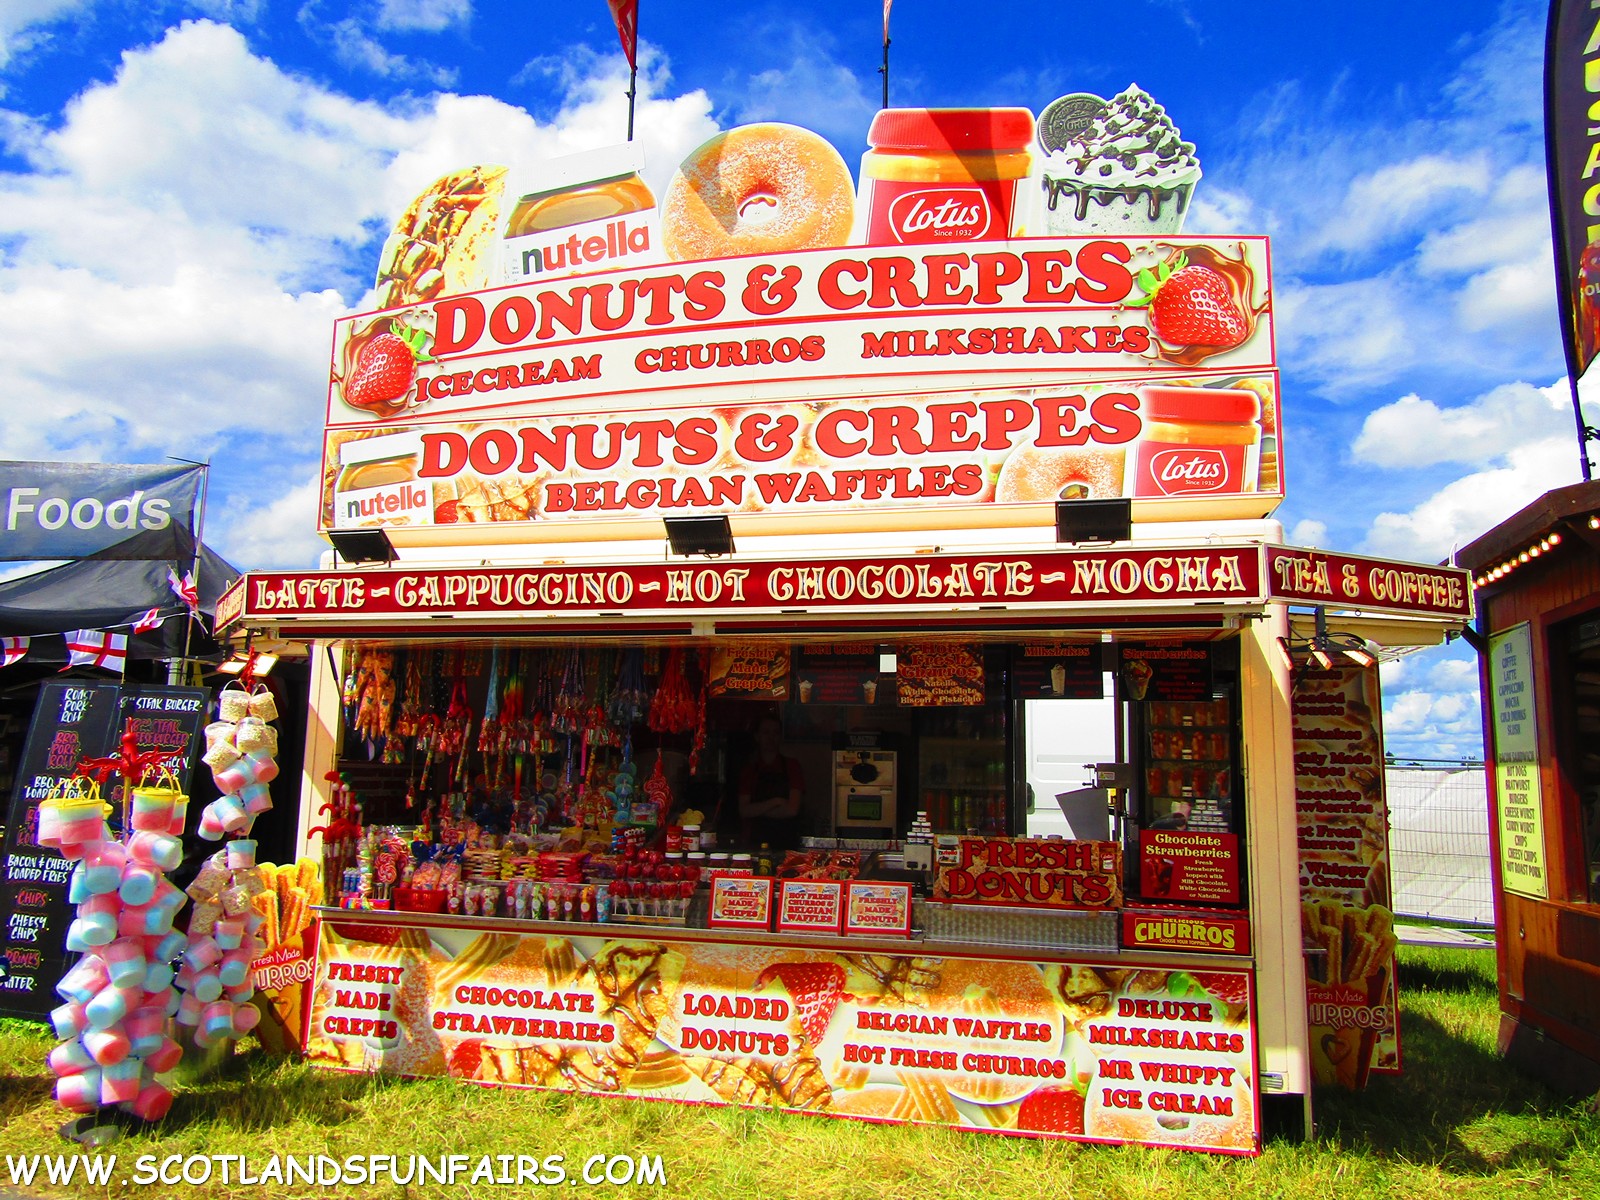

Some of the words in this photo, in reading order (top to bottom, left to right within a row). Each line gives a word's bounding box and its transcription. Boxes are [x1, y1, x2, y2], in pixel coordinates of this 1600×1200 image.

[902, 197, 980, 233] Lotus
[934, 229, 953, 237] Since
[955, 229, 972, 237] 1932
[522, 221, 650, 275] nutella
[430, 273, 725, 357] DONUTS
[742, 265, 802, 316] &
[817, 240, 1134, 309] CREPES
[415, 354, 602, 402] ICECREAM
[635, 335, 825, 374] CHURROS
[861, 326, 1151, 359] MILKSHAKES
[417, 407, 718, 478] DONUTS
[735, 413, 798, 462] &
[815, 393, 1143, 458] CREPES
[1160, 456, 1221, 481] Lotus
[544, 475, 746, 513] BELGIAN
[755, 464, 983, 506] WAFFLES
[1185, 478, 1200, 486] Since
[7, 487, 171, 530] Foods
[347, 484, 427, 518] nutella
[255, 577, 365, 609] LATTE
[395, 570, 633, 607] CAPPUCCINO
[665, 567, 750, 604] HOT
[766, 560, 1035, 602] CHOCOLATE
[1069, 555, 1246, 596] MOCHA
[1274, 555, 1333, 595] TEA
[1342, 564, 1360, 597] &
[1369, 567, 1464, 608] COFFEE
[732, 663, 768, 674] Made
[911, 654, 966, 666] Fresh
[726, 677, 772, 691] Crepes
[901, 666, 978, 679] Churros
[64, 700, 88, 711] PORK
[65, 688, 95, 700] ROAST
[136, 698, 162, 710] STEAK
[165, 699, 200, 711] BURGER
[34, 776, 54, 787] BBQ
[1155, 833, 1221, 846] Chocolate
[8, 854, 36, 867] BACON
[46, 857, 74, 870] CHEESE
[961, 840, 1093, 871] FRESH
[1146, 845, 1231, 858] Strawberries
[8, 867, 40, 880] LOADED
[945, 869, 1111, 901] DONUTS
[10, 914, 47, 928] CHEESY
[722, 909, 758, 917] CREPES
[787, 906, 833, 914] BELGIAN
[787, 914, 833, 922] WAFFLES
[857, 915, 898, 923] DONUTS
[1135, 922, 1235, 948] CHURROS
[275, 948, 300, 964] Made
[328, 963, 403, 985] FRESHY
[335, 990, 391, 1011] MADE
[455, 986, 595, 1013] CHOCOLATE
[1307, 988, 1333, 1000] Fresh
[1335, 990, 1363, 1003] Made
[683, 994, 789, 1021] LOADED
[1118, 998, 1213, 1022] DELUXE
[324, 1016, 398, 1039] CREPES
[432, 1012, 615, 1042] STRAWBERRIES
[857, 1011, 948, 1035] BELGIAN
[952, 1018, 1052, 1043] WAFFLES
[1089, 1024, 1244, 1053] MILKSHAKES
[681, 1027, 789, 1056] DONUTS
[843, 1044, 886, 1064] HOT
[889, 1047, 957, 1071] FRESH
[962, 1052, 1067, 1079] CHURROS
[1098, 1059, 1134, 1079] MR
[1139, 1061, 1235, 1087] WHIPPY
[1102, 1088, 1143, 1109] ICE
[1148, 1092, 1234, 1116] CREAM
